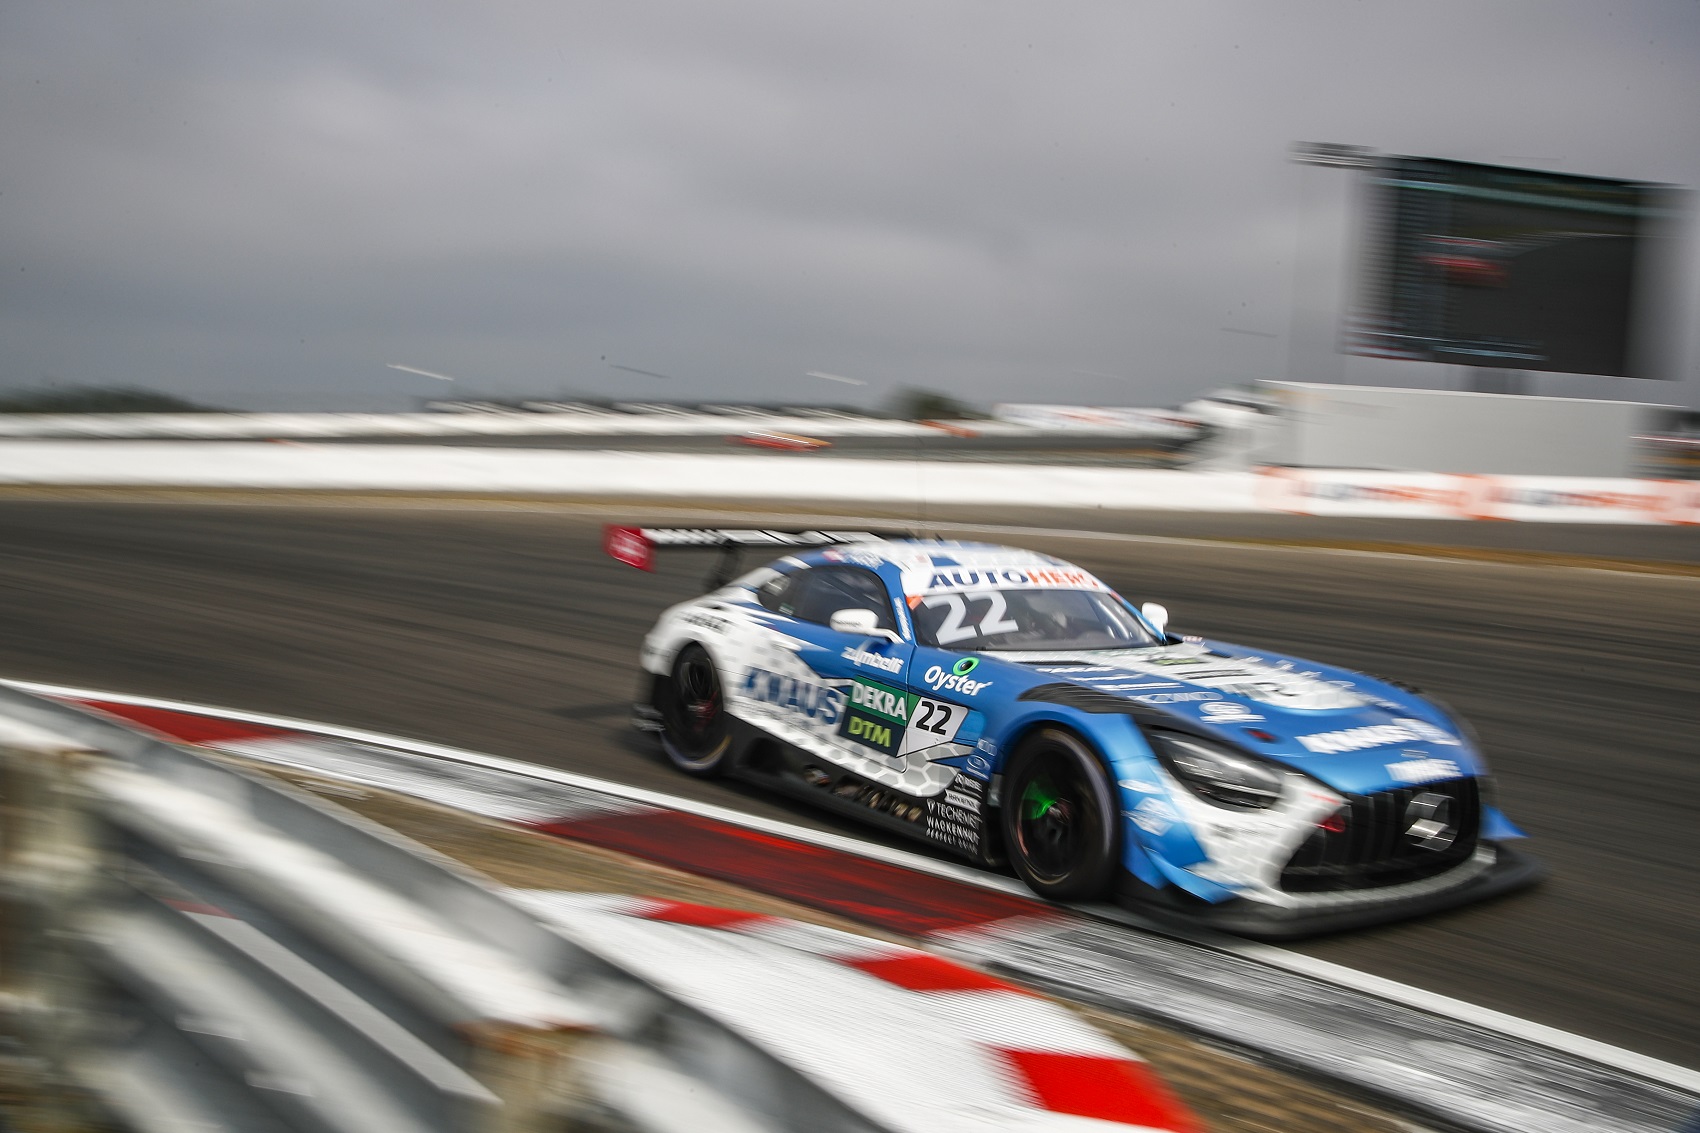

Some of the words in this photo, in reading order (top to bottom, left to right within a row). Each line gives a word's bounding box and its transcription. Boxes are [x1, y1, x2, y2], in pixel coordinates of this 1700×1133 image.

[922, 590, 1019, 645] 22
[924, 665, 993, 696] Oyster
[852, 682, 908, 721] DEKRA
[915, 700, 953, 736] 22
[848, 716, 891, 748] DTM
